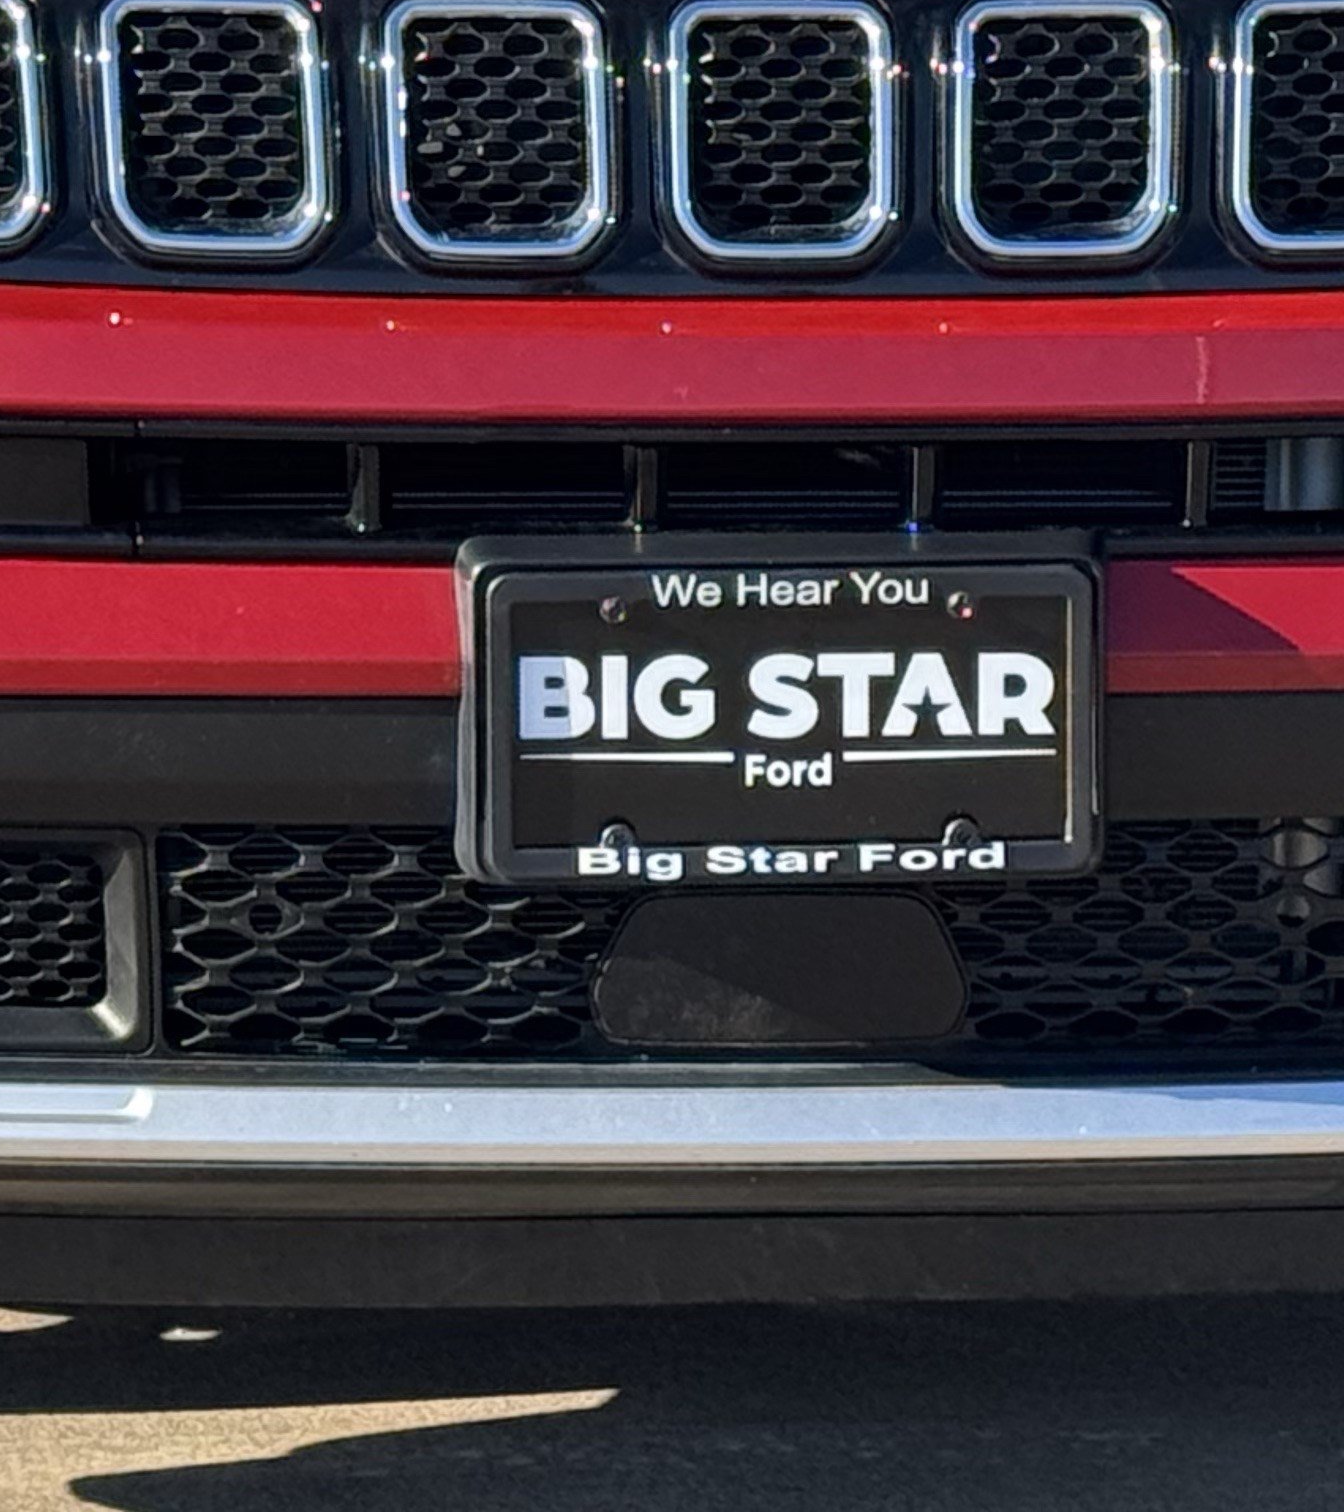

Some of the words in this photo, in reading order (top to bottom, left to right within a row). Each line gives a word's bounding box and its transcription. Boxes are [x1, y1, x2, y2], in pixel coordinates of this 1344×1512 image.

[651, 573, 723, 608] We
[736, 572, 840, 607] Hear
[849, 570, 930, 605] You
[519, 653, 716, 740] BIG
[747, 651, 1057, 739] STAR
[743, 751, 833, 787] Ford
[577, 845, 684, 881] Big
[705, 844, 840, 875] Star
[857, 841, 1007, 872] Ford
